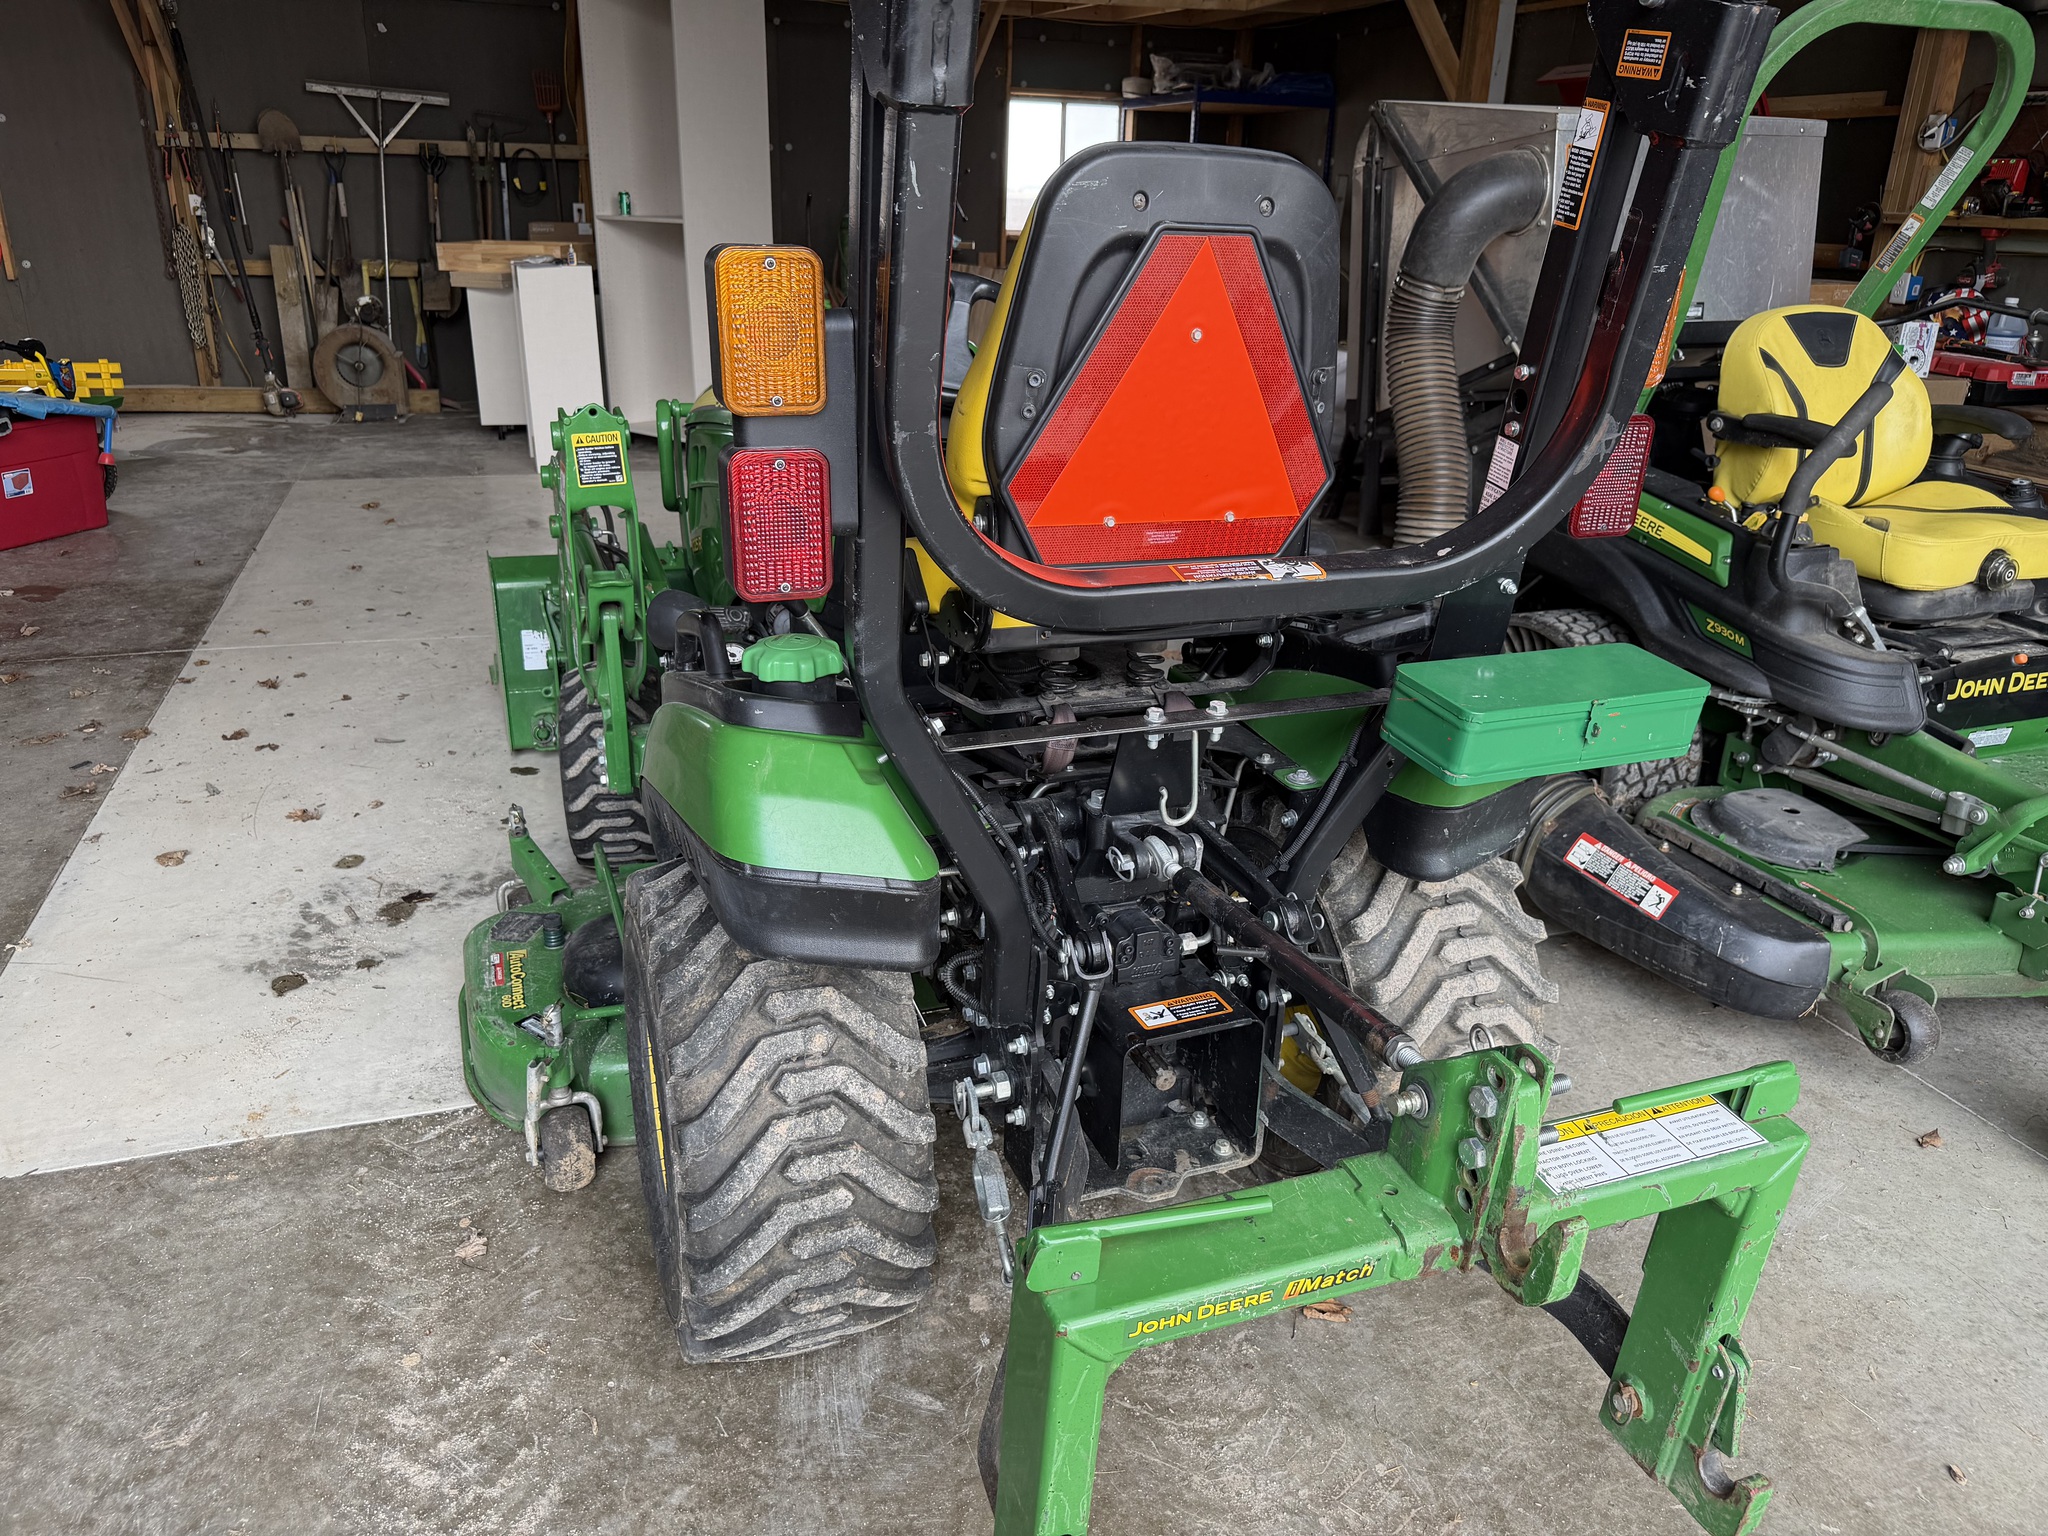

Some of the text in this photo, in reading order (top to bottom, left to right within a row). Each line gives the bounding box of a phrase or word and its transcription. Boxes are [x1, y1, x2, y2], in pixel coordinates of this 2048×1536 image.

[1619, 65, 1652, 76] WARNING
[585, 433, 618, 443] CAUTION
[1634, 514, 1664, 537] EERE
[1706, 618, 1745, 646] Z930M
[1947, 672, 2048, 700] JOHN DEE
[1600, 844, 1626, 863] DANGER
[1630, 862, 1657, 882] PELIGRO
[508, 950, 528, 1010] AutoConnect
[502, 994, 512, 1008] 60D
[1173, 993, 1212, 1004] WARNING
[1594, 1097, 1706, 1128] PRECAUCIÓN ATTENTION
[1565, 1141, 1588, 1150] SECURE
[1538, 1148, 1591, 1165] RACTOR IMPLEMENT
[1558, 1161, 1574, 1171] BOTH
[1574, 1156, 1598, 1166] LOCKING
[1568, 1168, 1584, 1176] OVER
[1583, 1163, 1603, 1172] LOWER
[1562, 1174, 1592, 1185] MPLEMENT
[1128, 1262, 1376, 1339] JOHN DEERE iMatch
